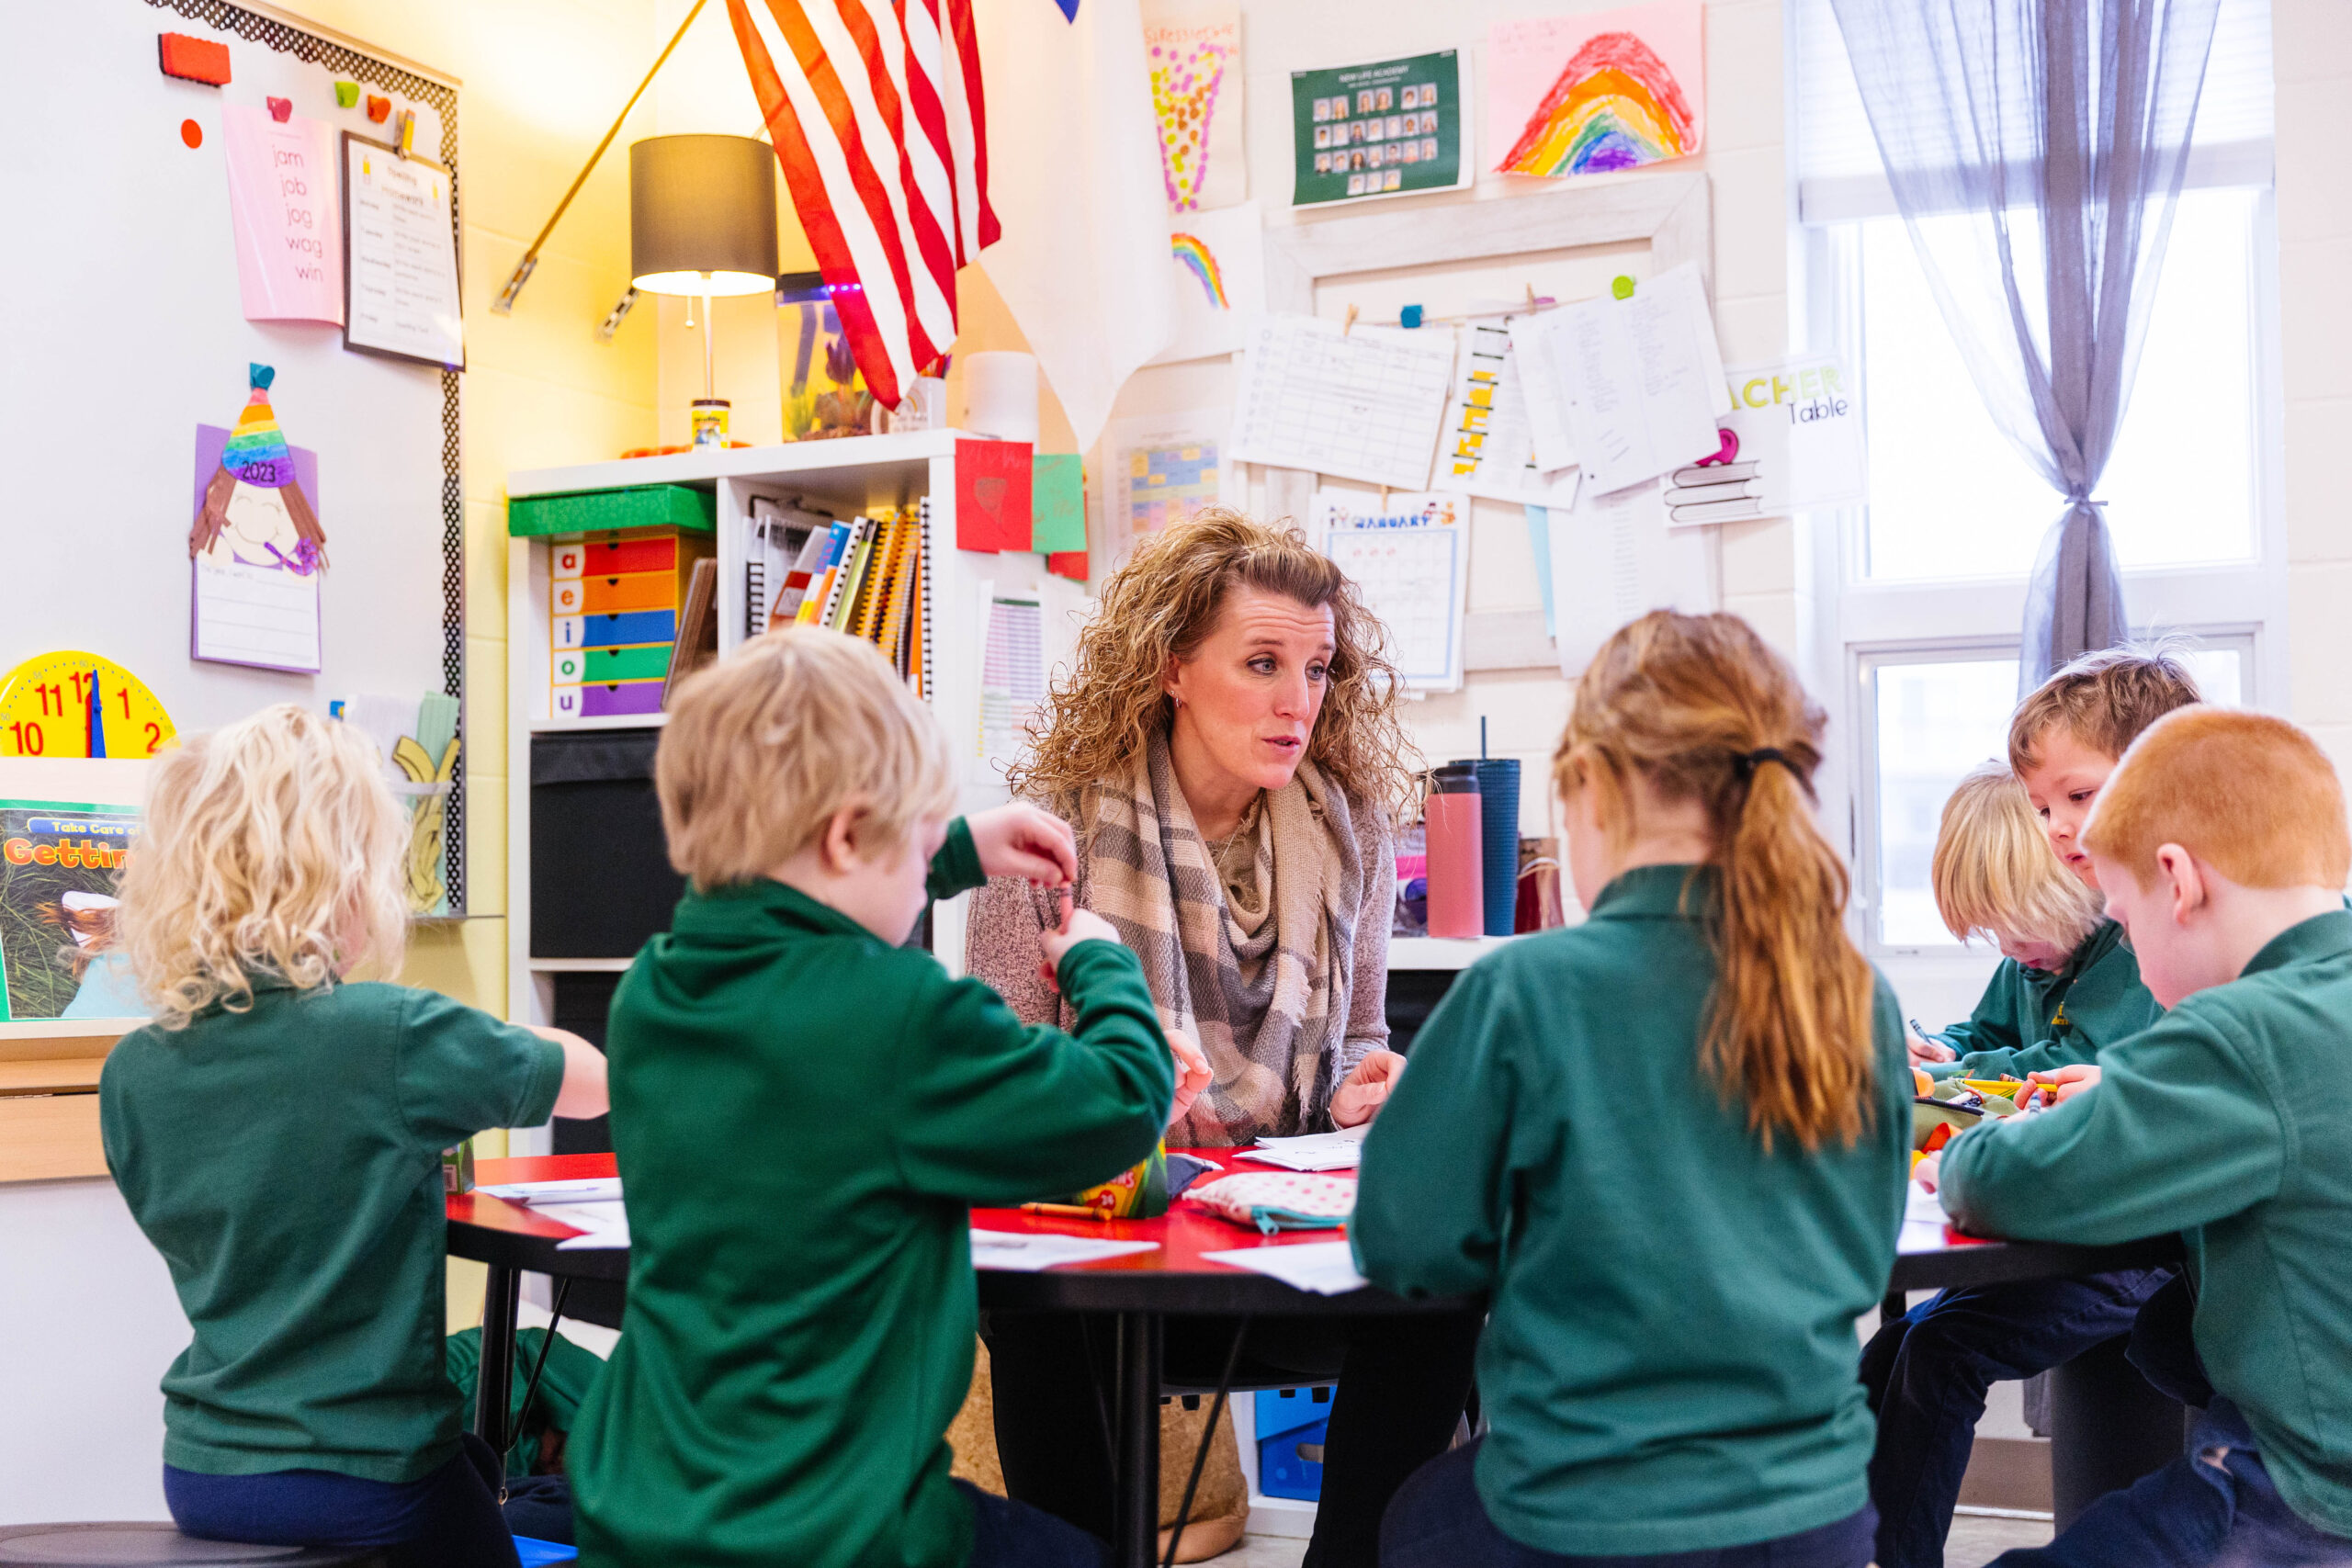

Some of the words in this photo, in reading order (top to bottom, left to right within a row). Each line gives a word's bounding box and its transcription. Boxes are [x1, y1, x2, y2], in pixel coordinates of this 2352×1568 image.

[272, 144, 304, 167] jam
[280, 174, 307, 197] job
[286, 203, 312, 229] jog
[285, 236, 322, 258] wag
[295, 263, 324, 282] win
[1787, 397, 1848, 424] Table
[242, 460, 277, 482] 2023
[1355, 515, 1430, 529] JANUARY
[561, 553, 576, 570] a
[560, 589, 574, 606] e
[565, 621, 571, 644] i
[561, 660, 575, 675] o
[35, 683, 62, 717] 11
[118, 688, 130, 719] 1
[560, 695, 572, 711] u
[9, 721, 43, 756] 10
[144, 722, 162, 753] 2
[51, 822, 87, 833] Take
[90, 825, 124, 835] Care
[1101, 1194, 1114, 1205] 24
